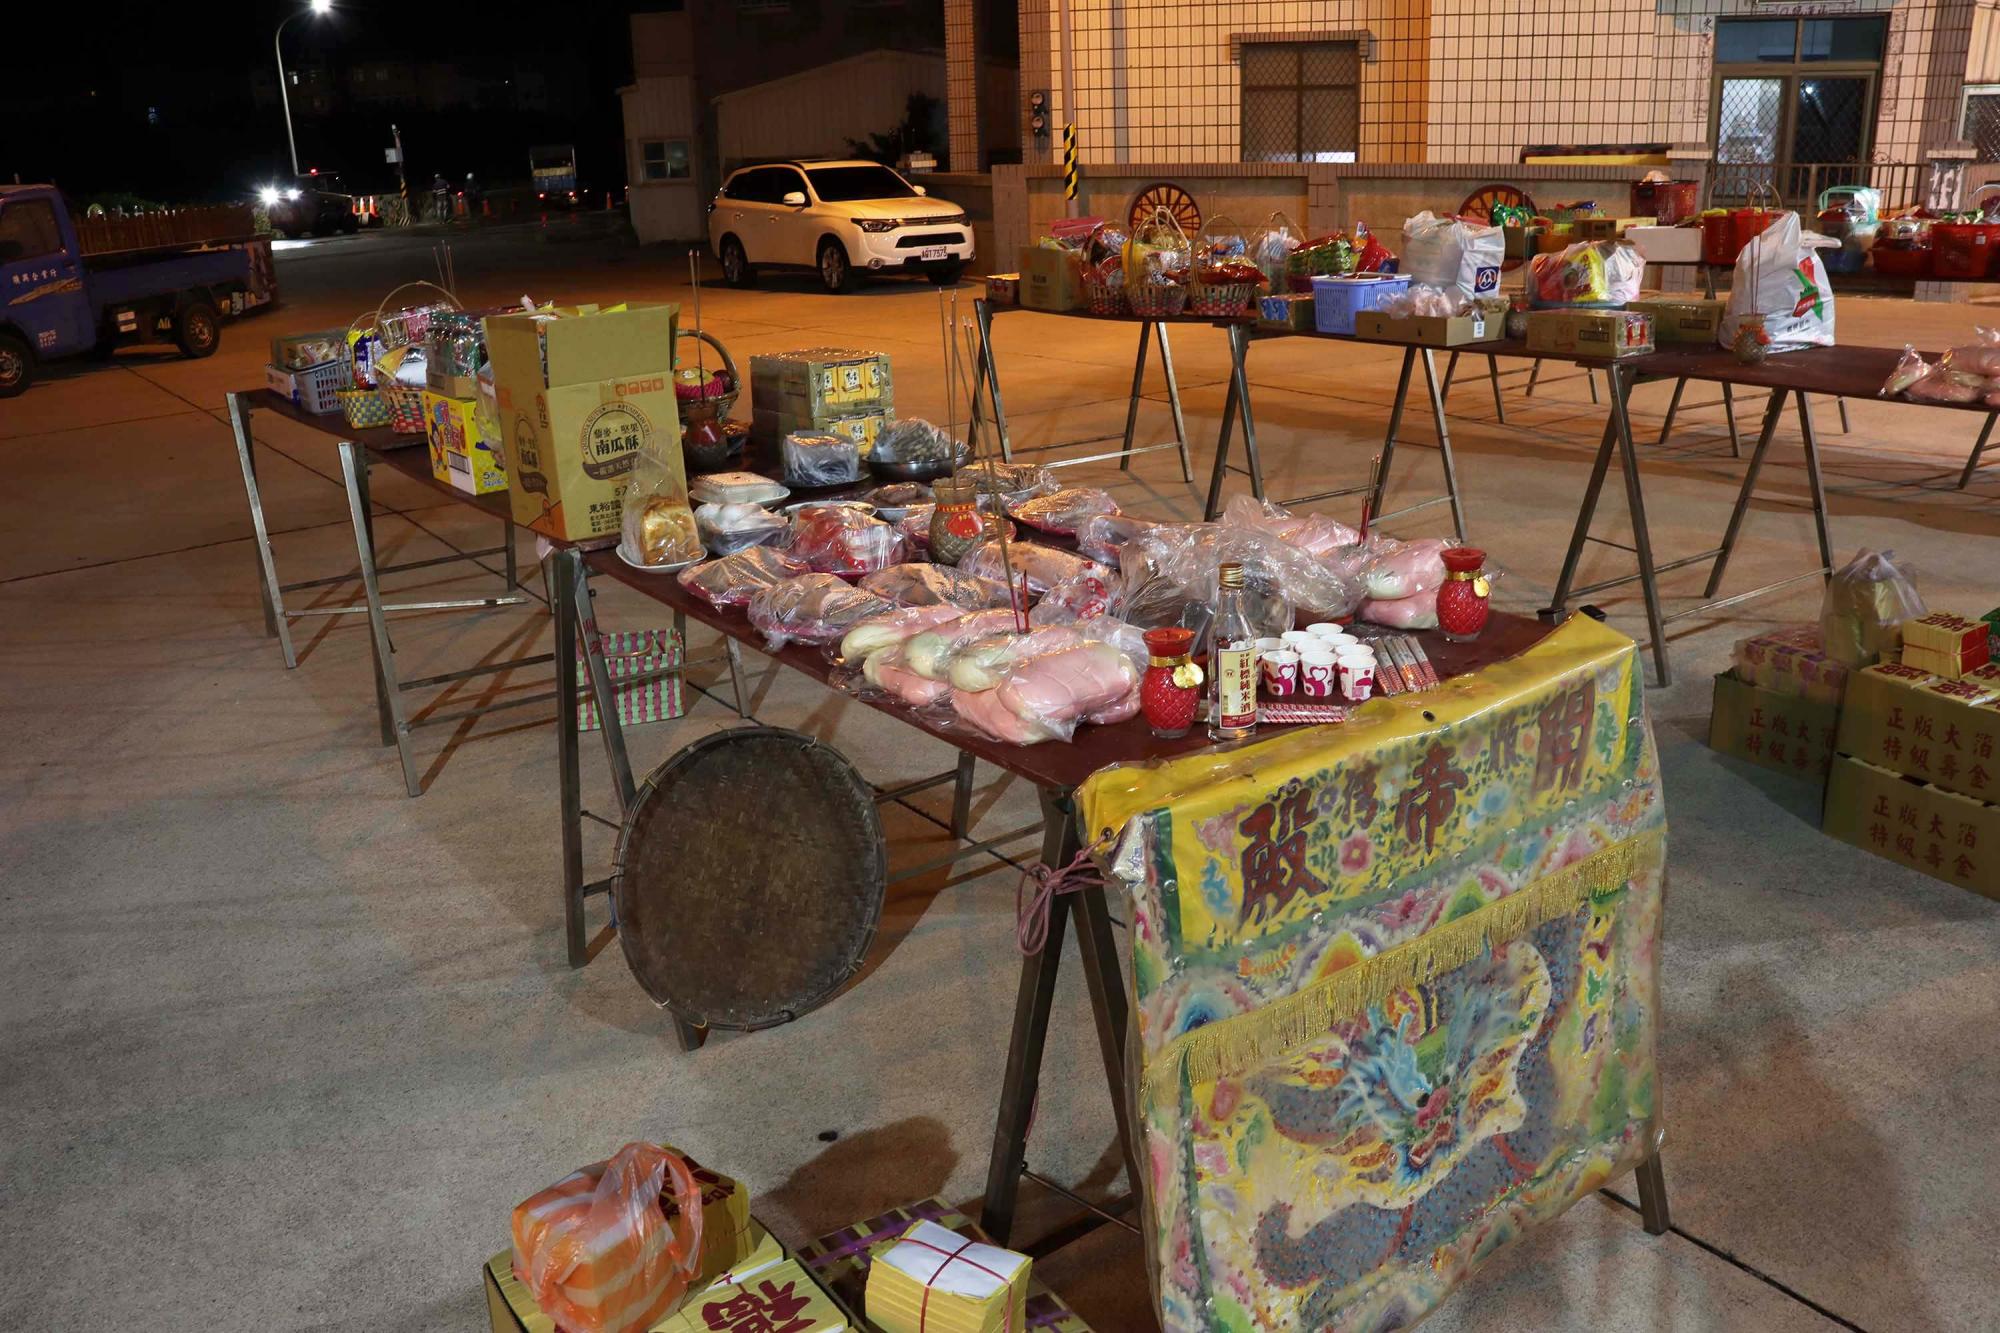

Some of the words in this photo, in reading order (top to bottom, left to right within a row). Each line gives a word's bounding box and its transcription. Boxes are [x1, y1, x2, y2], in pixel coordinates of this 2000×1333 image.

[595, 434, 640, 457] 南瓜酥
[1239, 658, 1251, 713] 紅標純米酒
[1887, 707, 1994, 760] 正版大箔
[1883, 736, 1993, 789] 特級壽金
[1873, 795, 1977, 849] 正版大箔
[1870, 822, 1977, 879] 特級壽金
